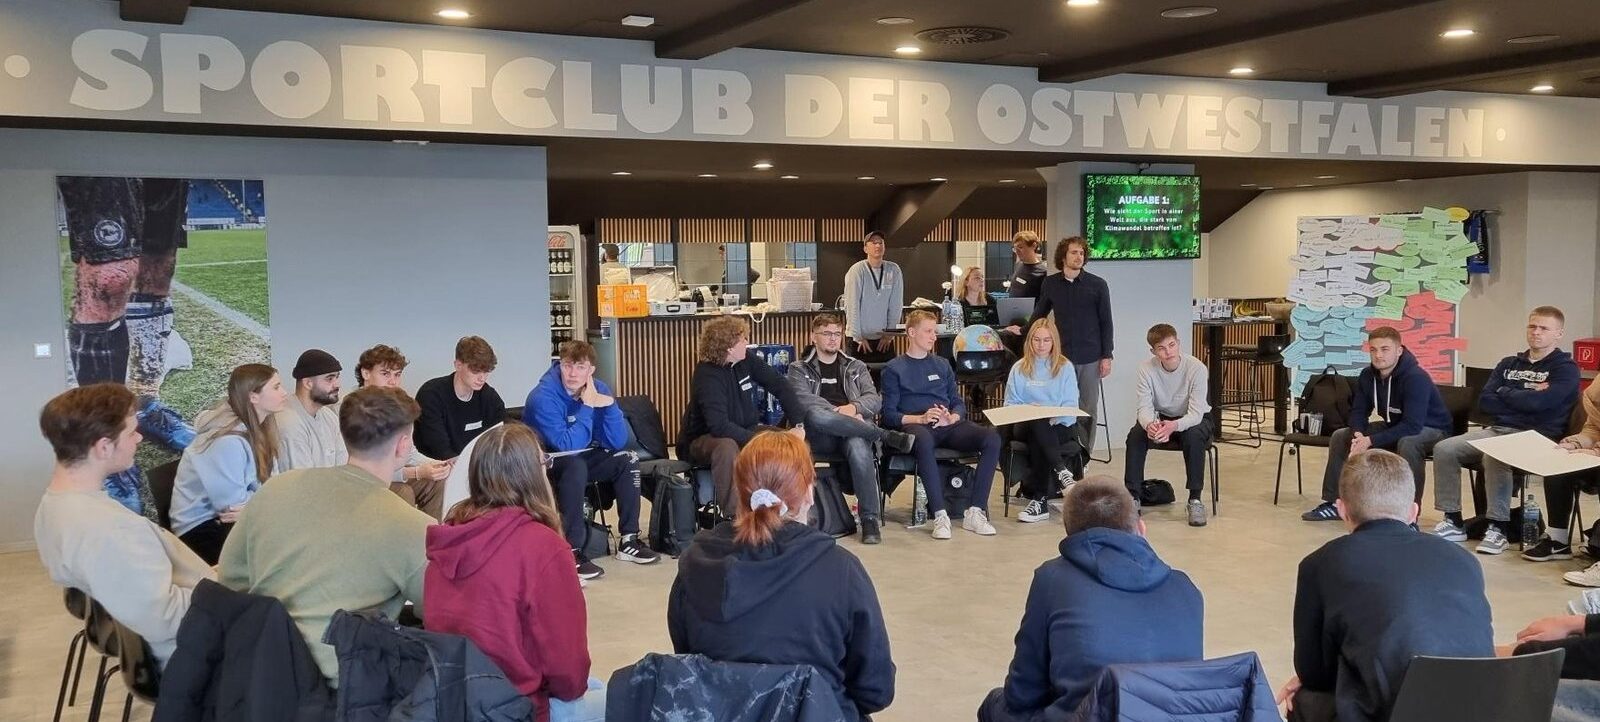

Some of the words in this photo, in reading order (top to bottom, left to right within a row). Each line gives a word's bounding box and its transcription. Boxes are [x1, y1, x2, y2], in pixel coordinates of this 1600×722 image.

[70, 28, 755, 137] SPORTCLUB
[784, 74, 955, 143] DER
[977, 83, 1484, 159] OSTWESTFALEN
[1118, 195, 1159, 205] AUFGABE
[1161, 195, 1170, 205] 1:
